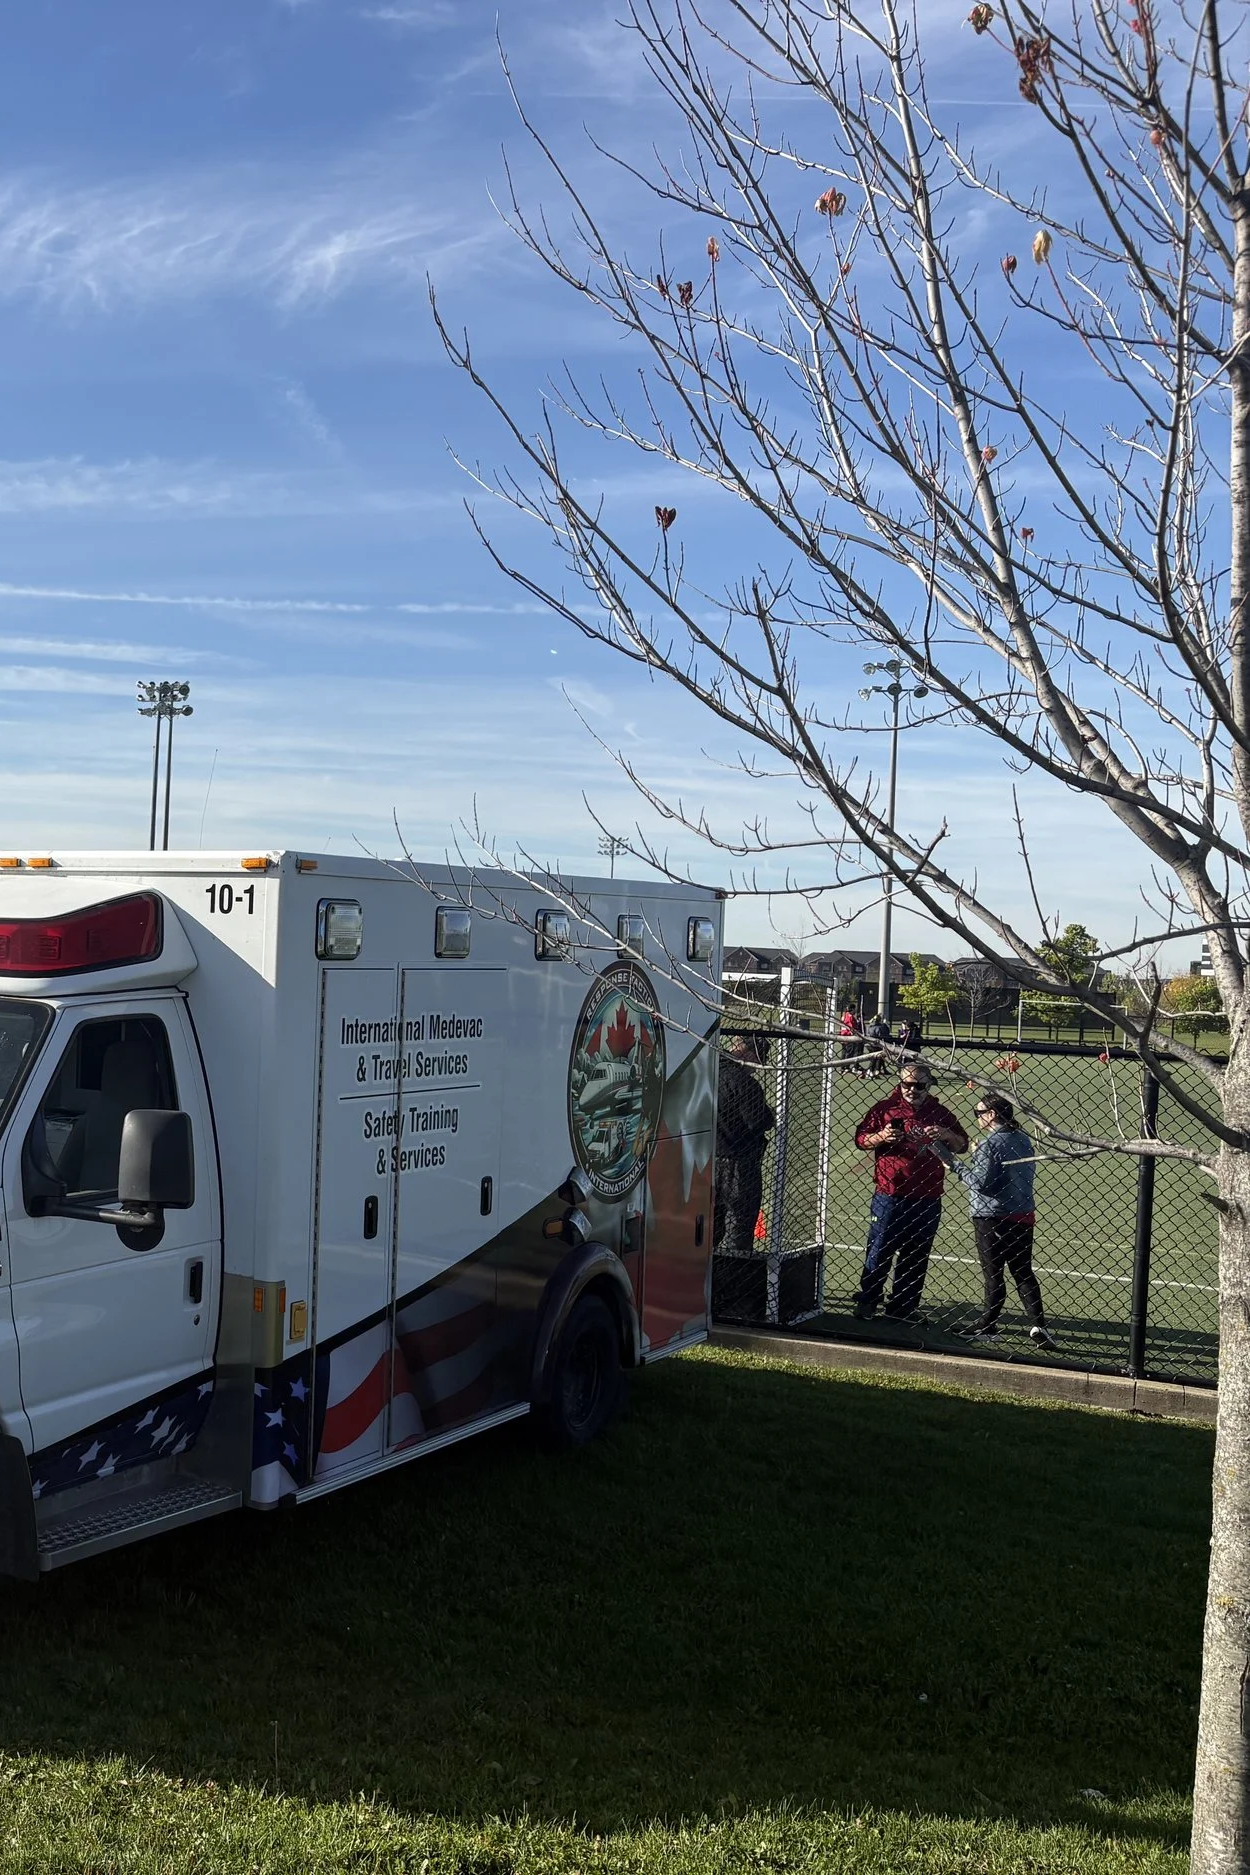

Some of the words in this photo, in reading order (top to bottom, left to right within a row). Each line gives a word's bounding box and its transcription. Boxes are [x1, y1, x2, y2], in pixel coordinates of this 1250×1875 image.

[205, 883, 255, 915] 10-1
[586, 972, 628, 1020] RESPONSE
[429, 1014, 483, 1040] Medevac
[356, 1055, 367, 1083] &
[372, 1052, 411, 1081] Travel
[415, 1050, 468, 1078] Services
[409, 1104, 459, 1133] Training
[376, 1148, 387, 1175] &
[390, 1143, 446, 1173] Services
[588, 1160, 645, 1194] INTERNATIONAL
